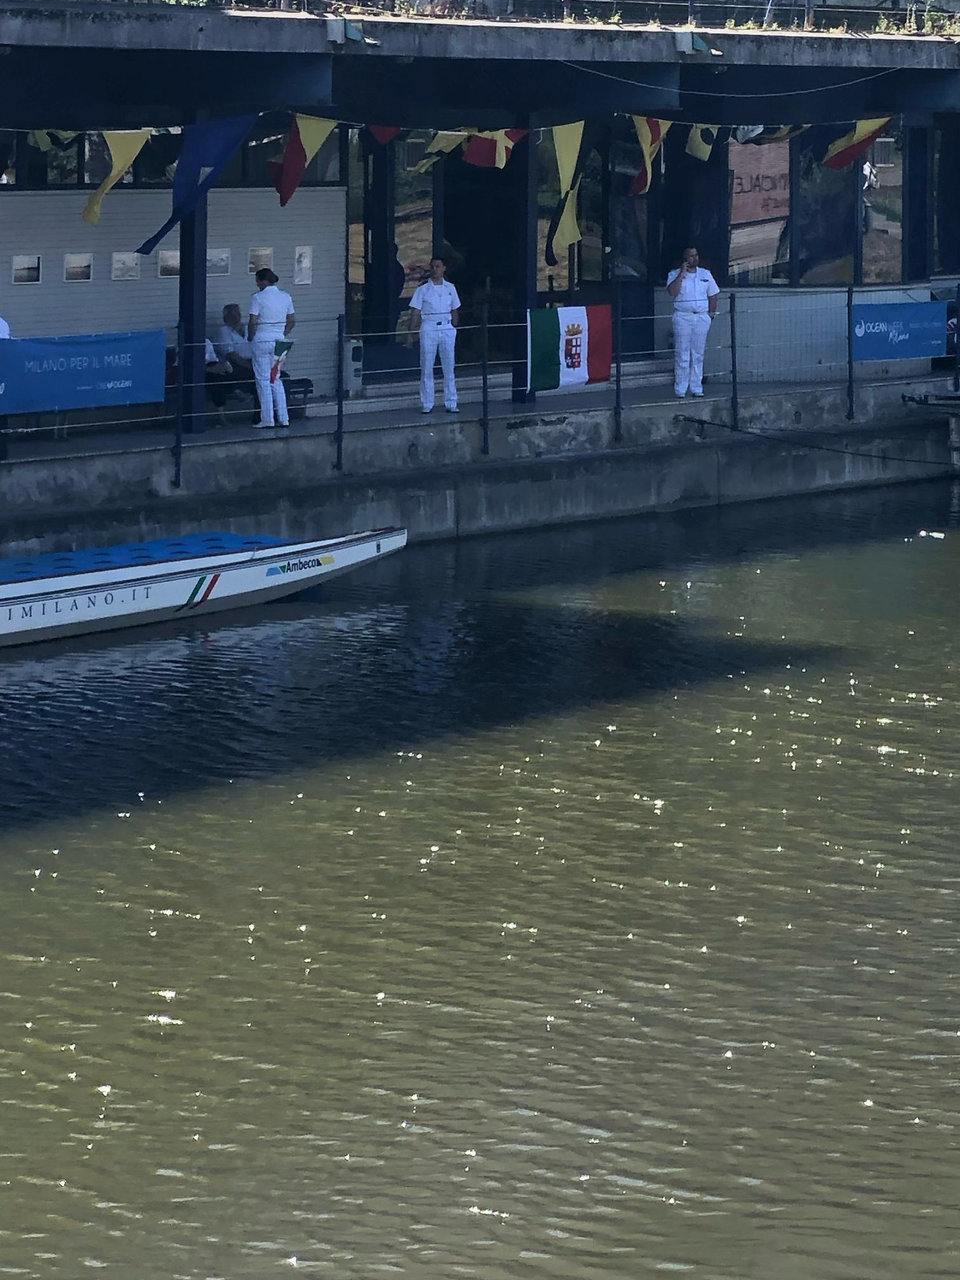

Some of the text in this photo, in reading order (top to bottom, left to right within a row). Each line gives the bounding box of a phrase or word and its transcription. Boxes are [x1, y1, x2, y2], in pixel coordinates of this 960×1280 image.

[865, 322, 888, 333] OCEAN
[25, 353, 132, 372] MILANO PER IL MARE
[286, 558, 317, 573] Ambeco
